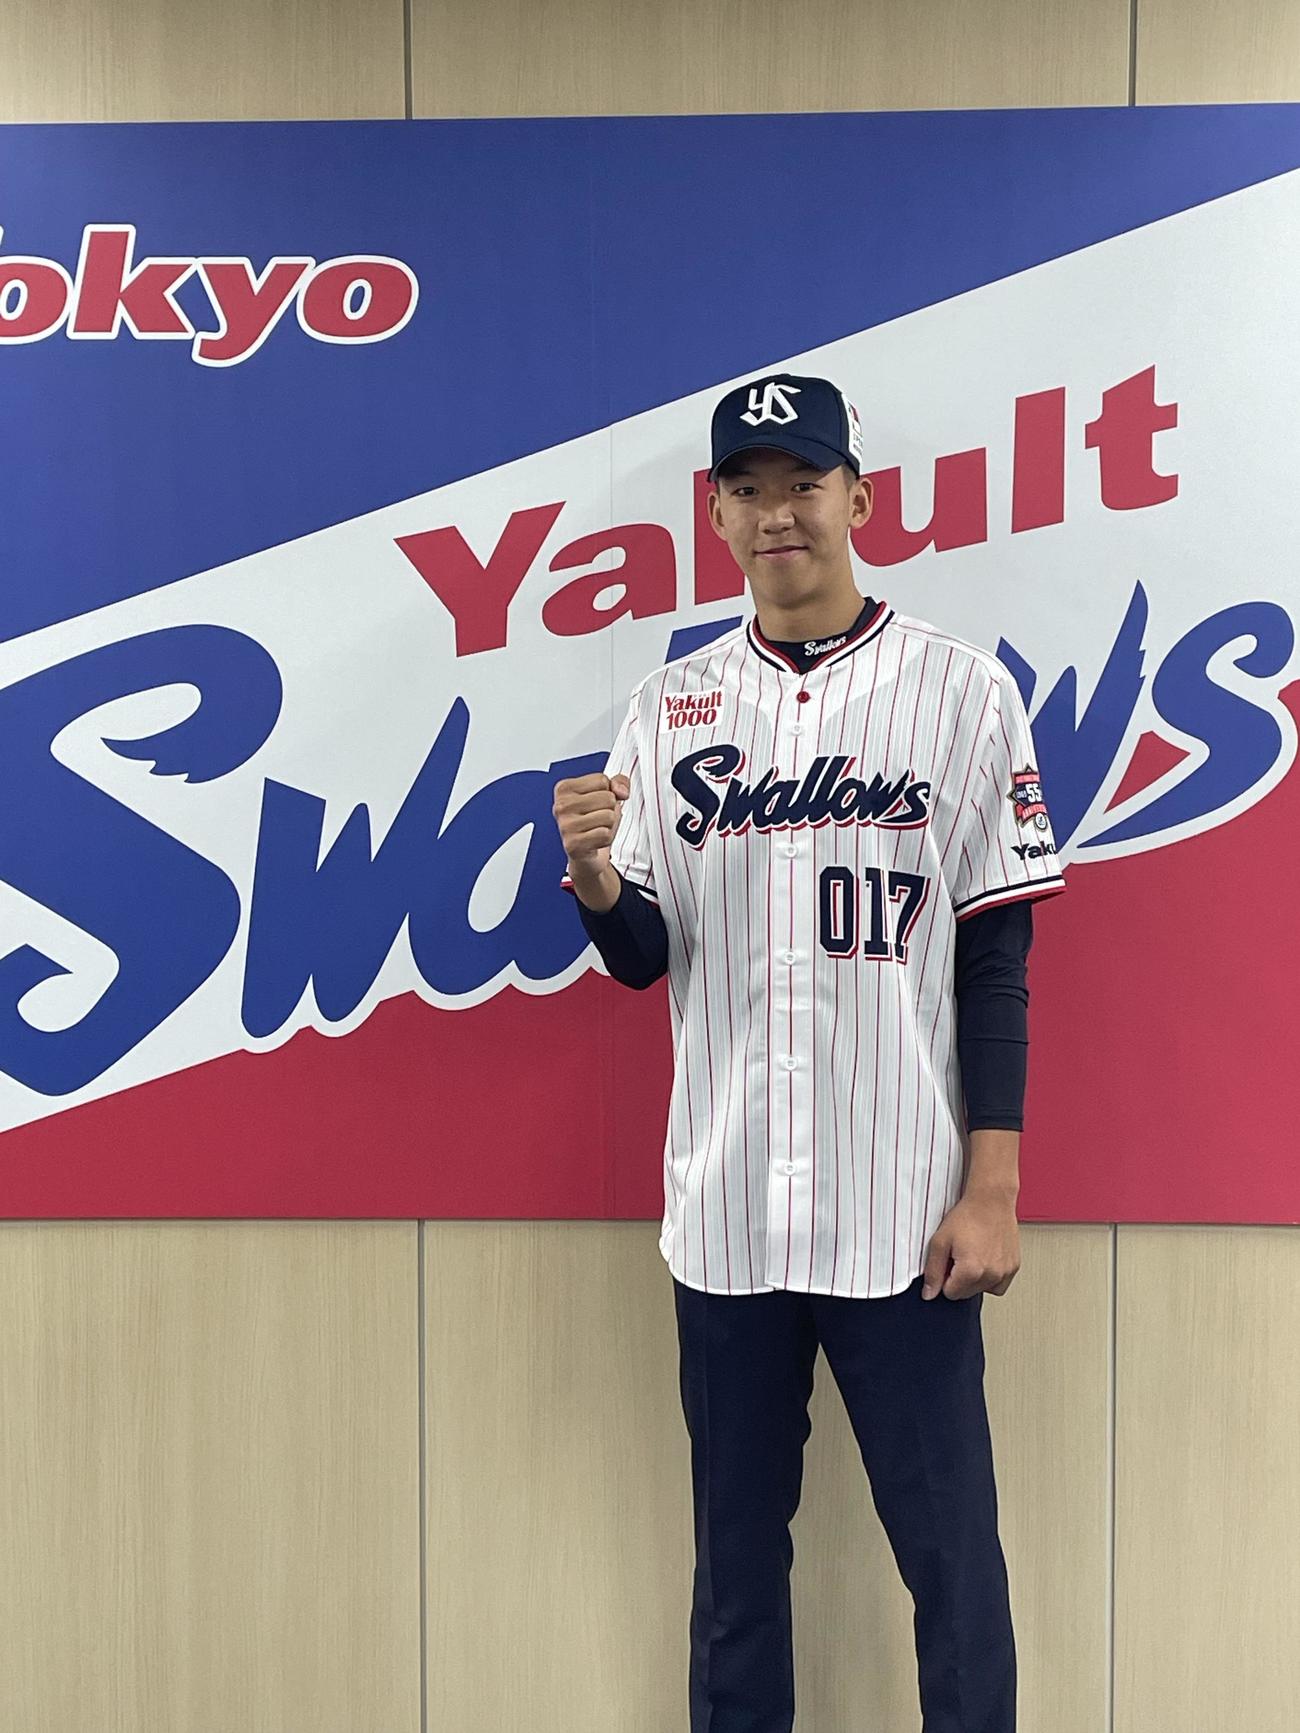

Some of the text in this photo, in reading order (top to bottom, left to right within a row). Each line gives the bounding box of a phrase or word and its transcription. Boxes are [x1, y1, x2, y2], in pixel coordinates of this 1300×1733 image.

[0, 224, 419, 367] okyo
[803, 635, 848, 657] Swallows
[664, 690, 723, 713] Yakult
[666, 708, 718, 731] 1000
[670, 743, 932, 851] Swallows
[1025, 782, 1043, 803] 55
[0, 578, 1295, 1097] Swaws
[818, 865, 932, 966] 017
